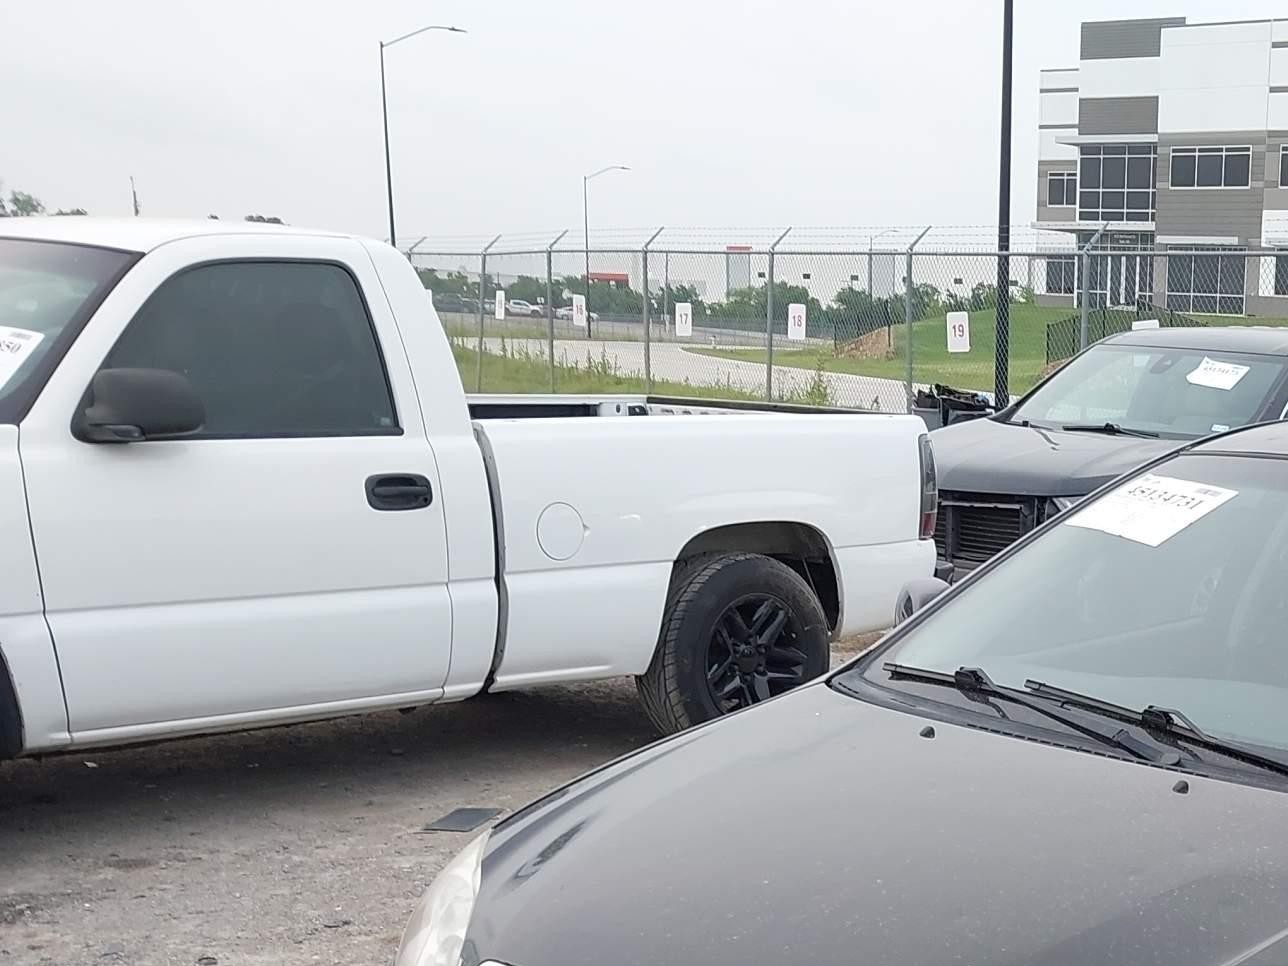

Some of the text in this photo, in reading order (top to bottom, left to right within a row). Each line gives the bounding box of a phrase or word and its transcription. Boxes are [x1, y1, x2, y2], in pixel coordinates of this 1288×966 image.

[679, 313, 689, 325] 17
[792, 314, 803, 327] 18
[952, 324, 965, 337] 19
[1127, 486, 1204, 510] 45134731
